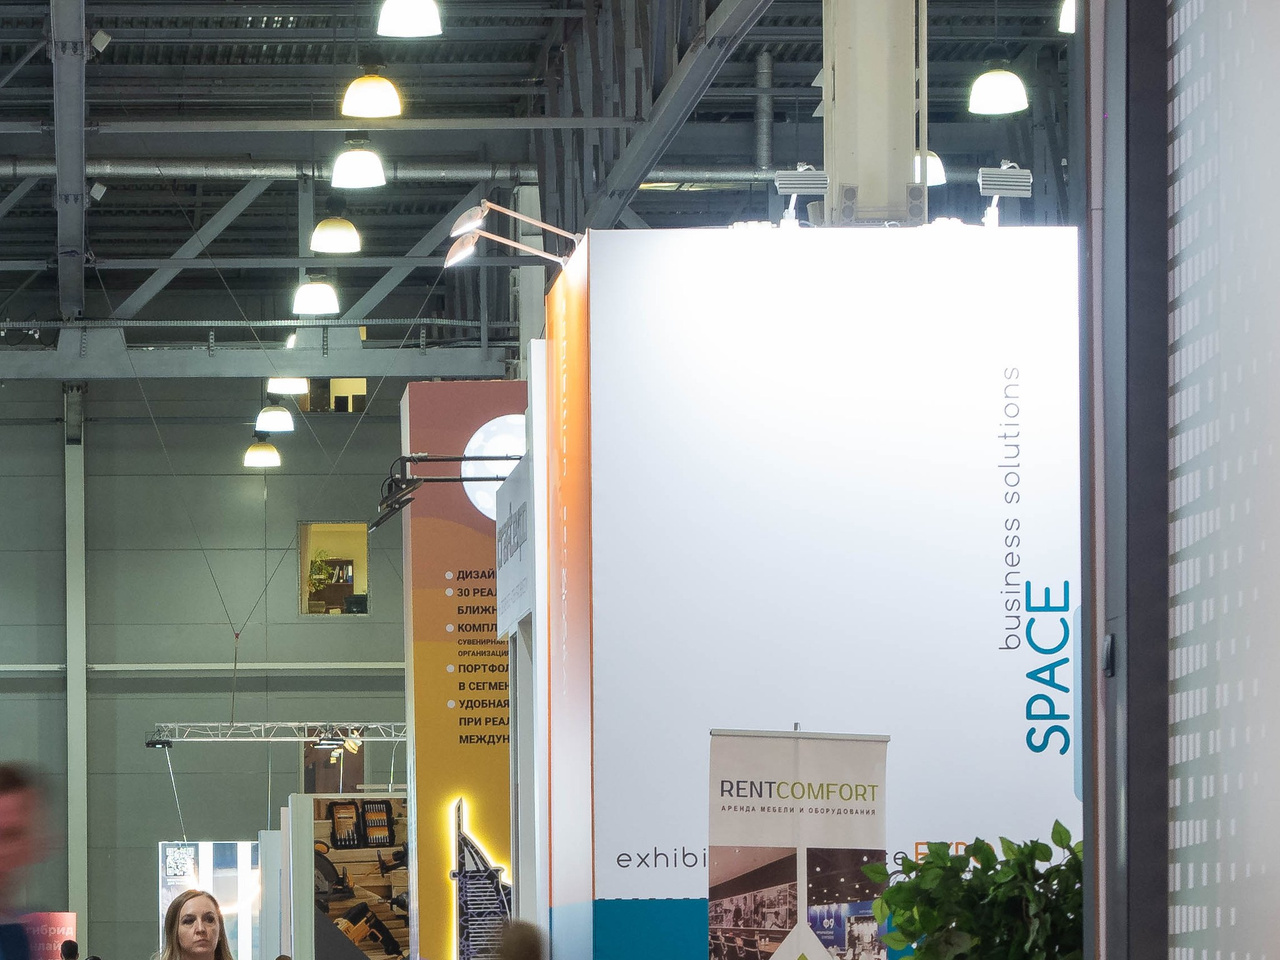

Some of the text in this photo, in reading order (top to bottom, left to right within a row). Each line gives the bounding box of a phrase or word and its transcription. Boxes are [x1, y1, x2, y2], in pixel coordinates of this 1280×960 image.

[998, 367, 1021, 650] business solutions
[457, 567, 496, 580] ДИЗАЙ
[457, 587, 496, 597] 30 РЕА
[457, 606, 497, 615] БЛИЖН
[458, 623, 497, 633] КОМПЛ
[1026, 580, 1070, 756] SPACE
[459, 681, 509, 691] В СЕГМЕН
[459, 699, 509, 711] УДОБНАЯ
[459, 717, 482, 726] ПРИ
[459, 735, 509, 746] МЕЖДУН
[720, 780, 879, 801] RENTCOMFORT
[721, 805, 756, 813] АРЕНДА
[760, 806, 795, 814] МЕБЕЛИ
[808, 807, 876, 816] ОБОРУДОВАНИЯ
[616, 846, 706, 868] exhibi
